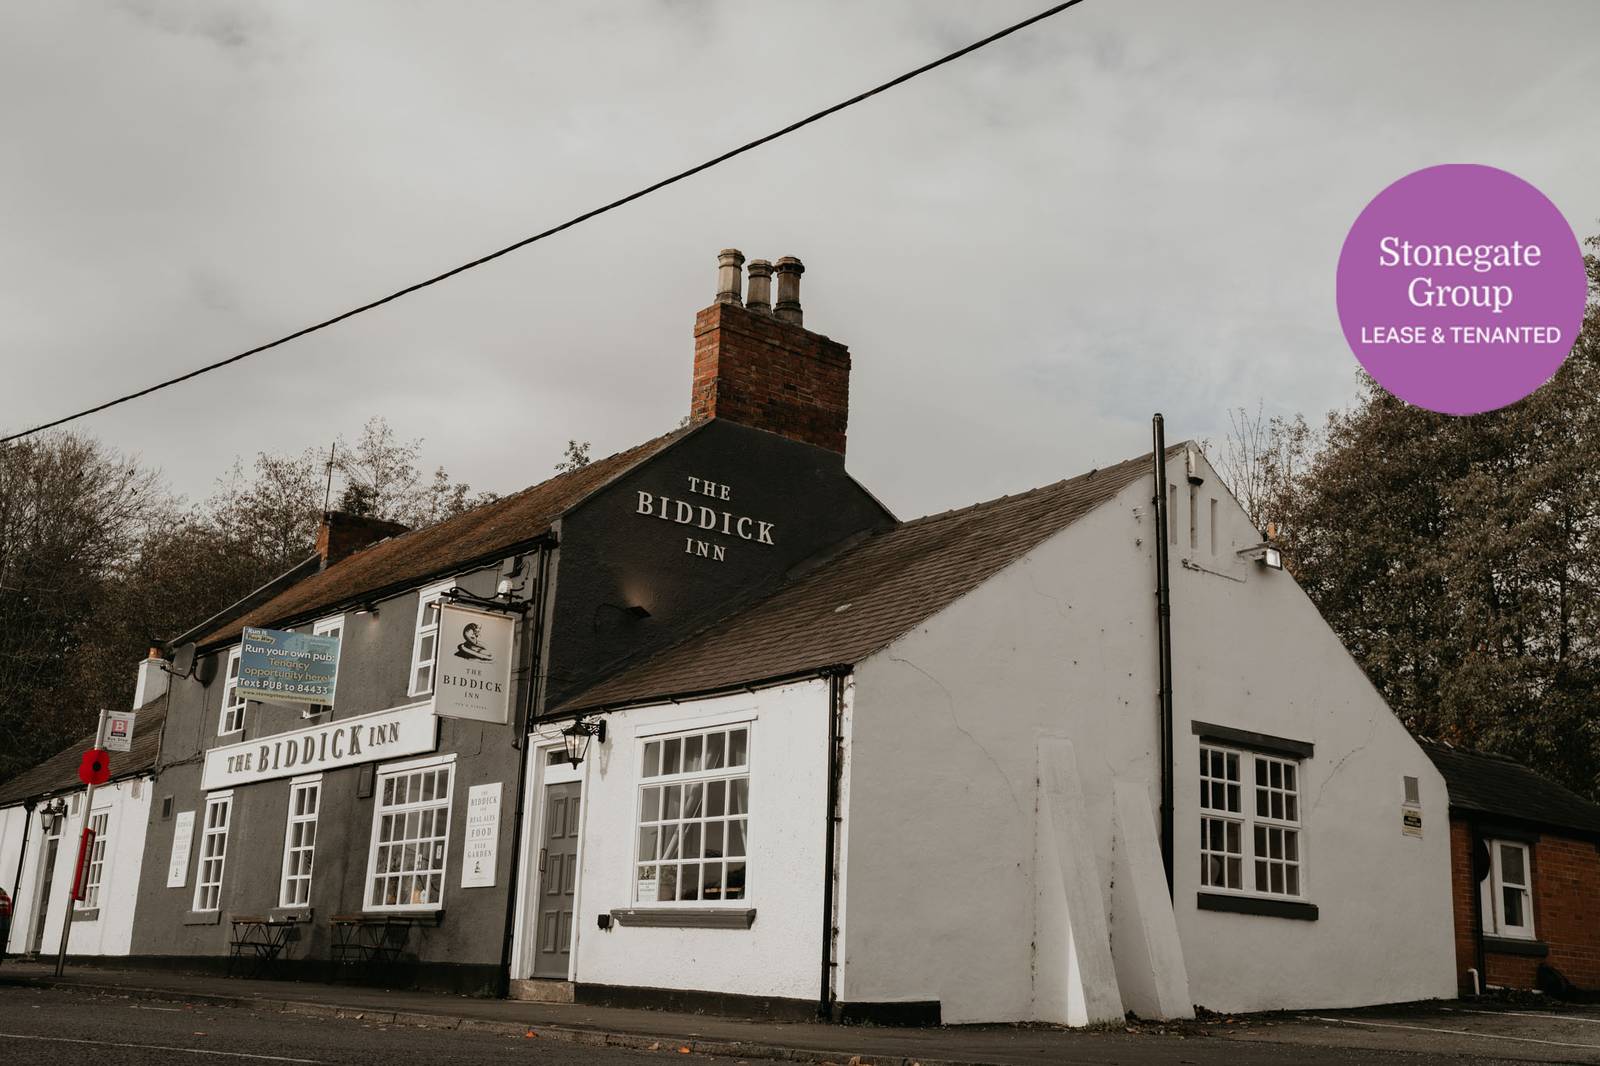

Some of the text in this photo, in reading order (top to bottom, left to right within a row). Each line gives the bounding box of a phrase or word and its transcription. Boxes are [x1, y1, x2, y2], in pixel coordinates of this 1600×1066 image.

[688, 476, 730, 501] THE
[636, 490, 775, 545] BIDDICK
[685, 537, 726, 562] INN
[245, 644, 335, 662] Run your own pub:
[244, 666, 305, 681] opportunity
[269, 658, 310, 671] Tenancy
[466, 668, 482, 676] THE
[240, 678, 328, 695] Text PUB to 84433
[443, 675, 502, 693] BIDDICK
[227, 722, 400, 773] THE BIDDICK INN
[472, 828, 492, 837] FOOD
